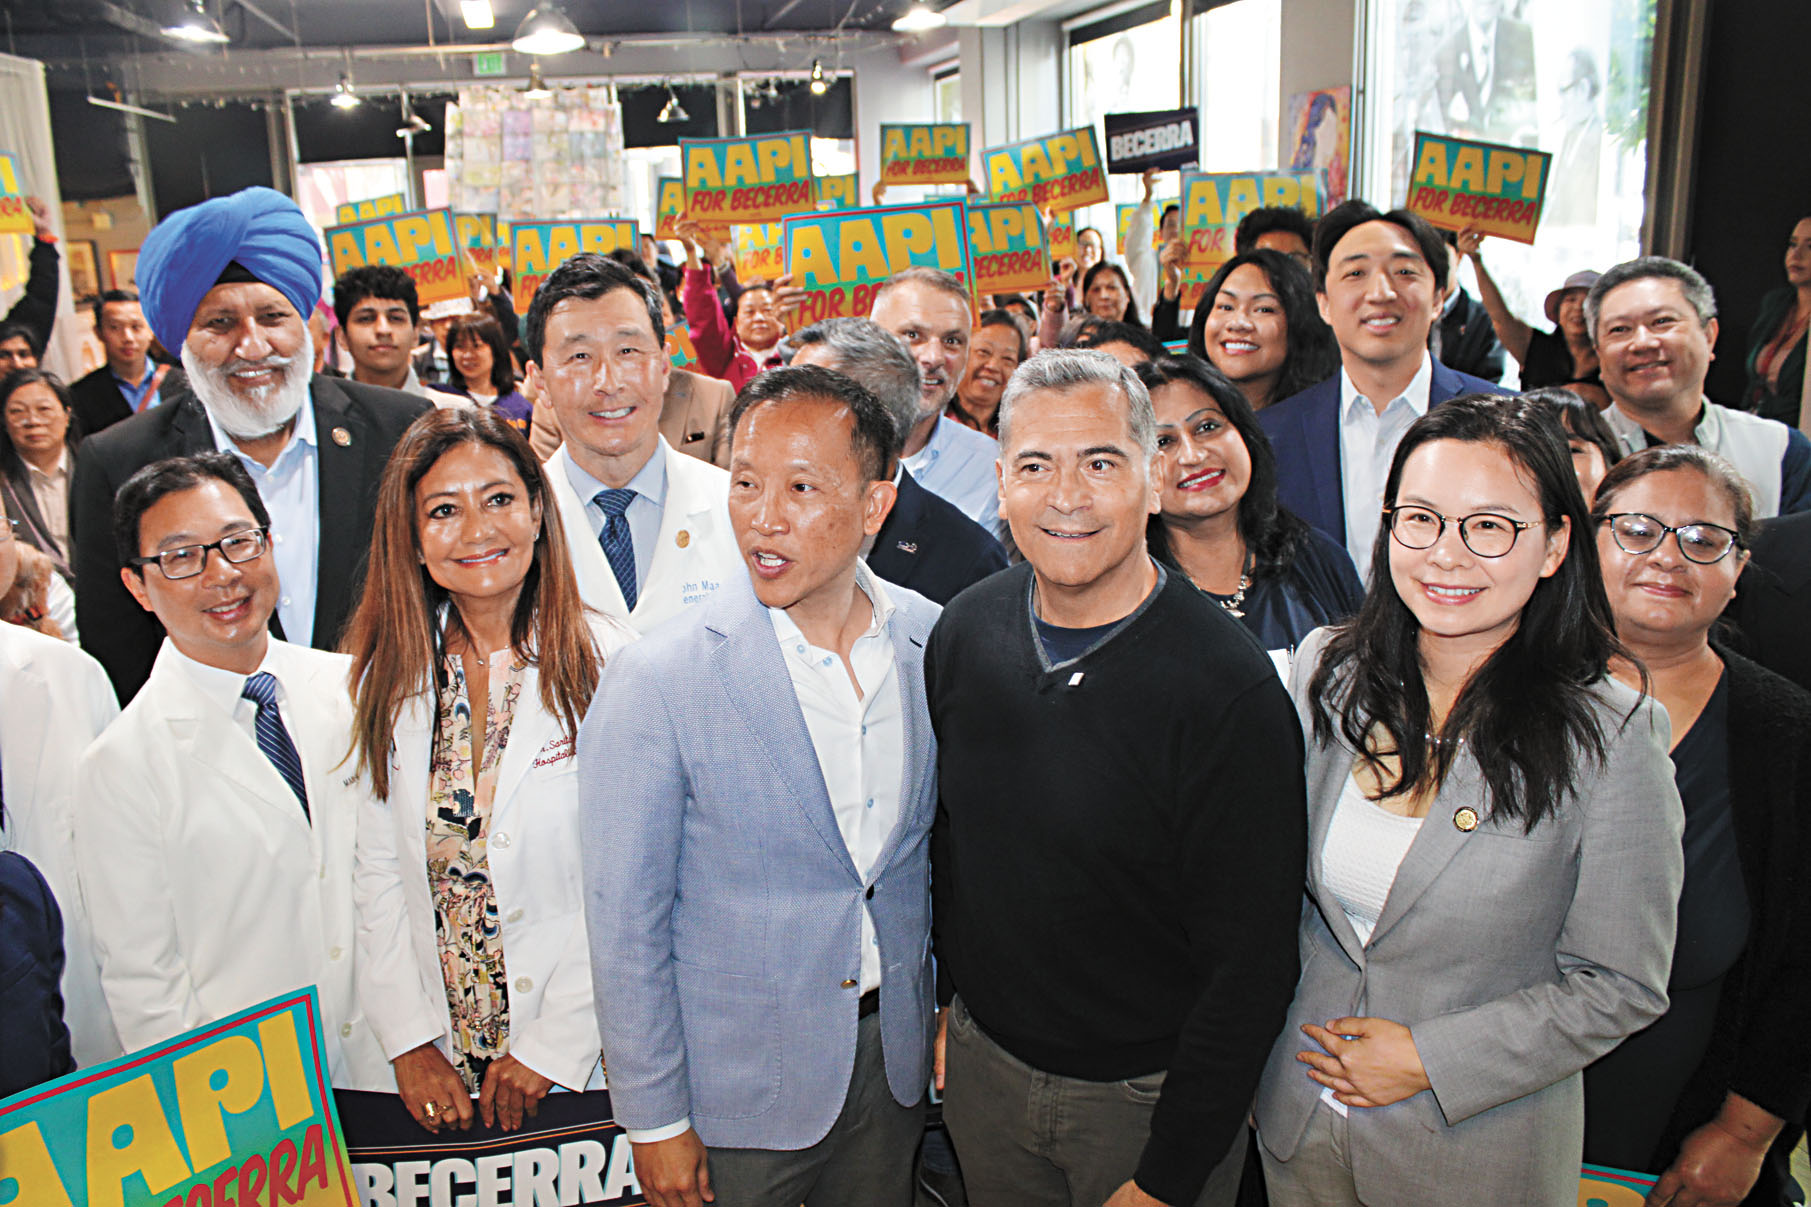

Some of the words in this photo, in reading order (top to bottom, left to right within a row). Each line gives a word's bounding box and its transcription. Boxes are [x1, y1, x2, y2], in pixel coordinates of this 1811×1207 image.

[687, 135, 809, 187] AAPI
[884, 125, 966, 158] AAPI
[989, 129, 1097, 193] AAPI
[1110, 119, 1194, 162] BECERRA
[886, 159, 911, 177] FOR
[912, 156, 966, 176] BECERRA
[1032, 167, 1100, 205] BECERRA
[1416, 140, 1542, 199] AAPI
[339, 194, 404, 224] AAPI
[690, 189, 726, 213] FOR
[729, 179, 810, 211] BECERRA
[1186, 175, 1317, 226] AAPI
[1413, 186, 1449, 214] FOR
[1450, 192, 1537, 226] BECERRA
[331, 211, 453, 276] AAPI
[515, 223, 633, 272] AAPI
[790, 208, 962, 288] AAPI
[969, 206, 1041, 253] API
[1188, 228, 1225, 255] FOR
[743, 248, 770, 270] FOR
[974, 248, 1042, 279] ECERRA
[520, 273, 548, 300] FO
[799, 287, 846, 326] FOR
[162, 1124, 328, 1207] ERRA
[350, 1133, 643, 1207] BECERRA
